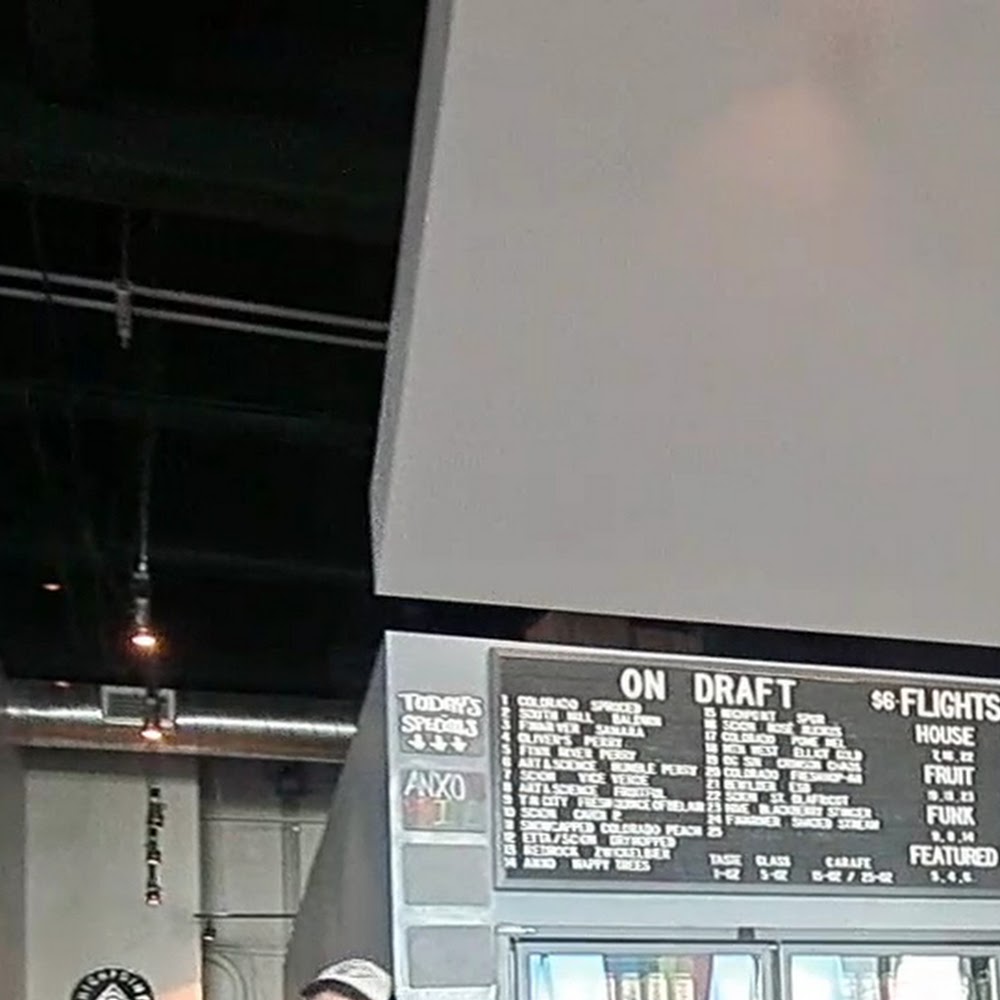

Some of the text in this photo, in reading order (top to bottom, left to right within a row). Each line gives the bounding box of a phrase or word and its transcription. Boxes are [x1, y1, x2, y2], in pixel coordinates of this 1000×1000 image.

[620, 668, 797, 709] ON DRAFT
[916, 725, 975, 745] HOUSE
[404, 771, 465, 800] ANXO
[924, 766, 975, 785] FRUIT
[927, 806, 975, 826] FUNK
[910, 845, 998, 866] FEATURED
